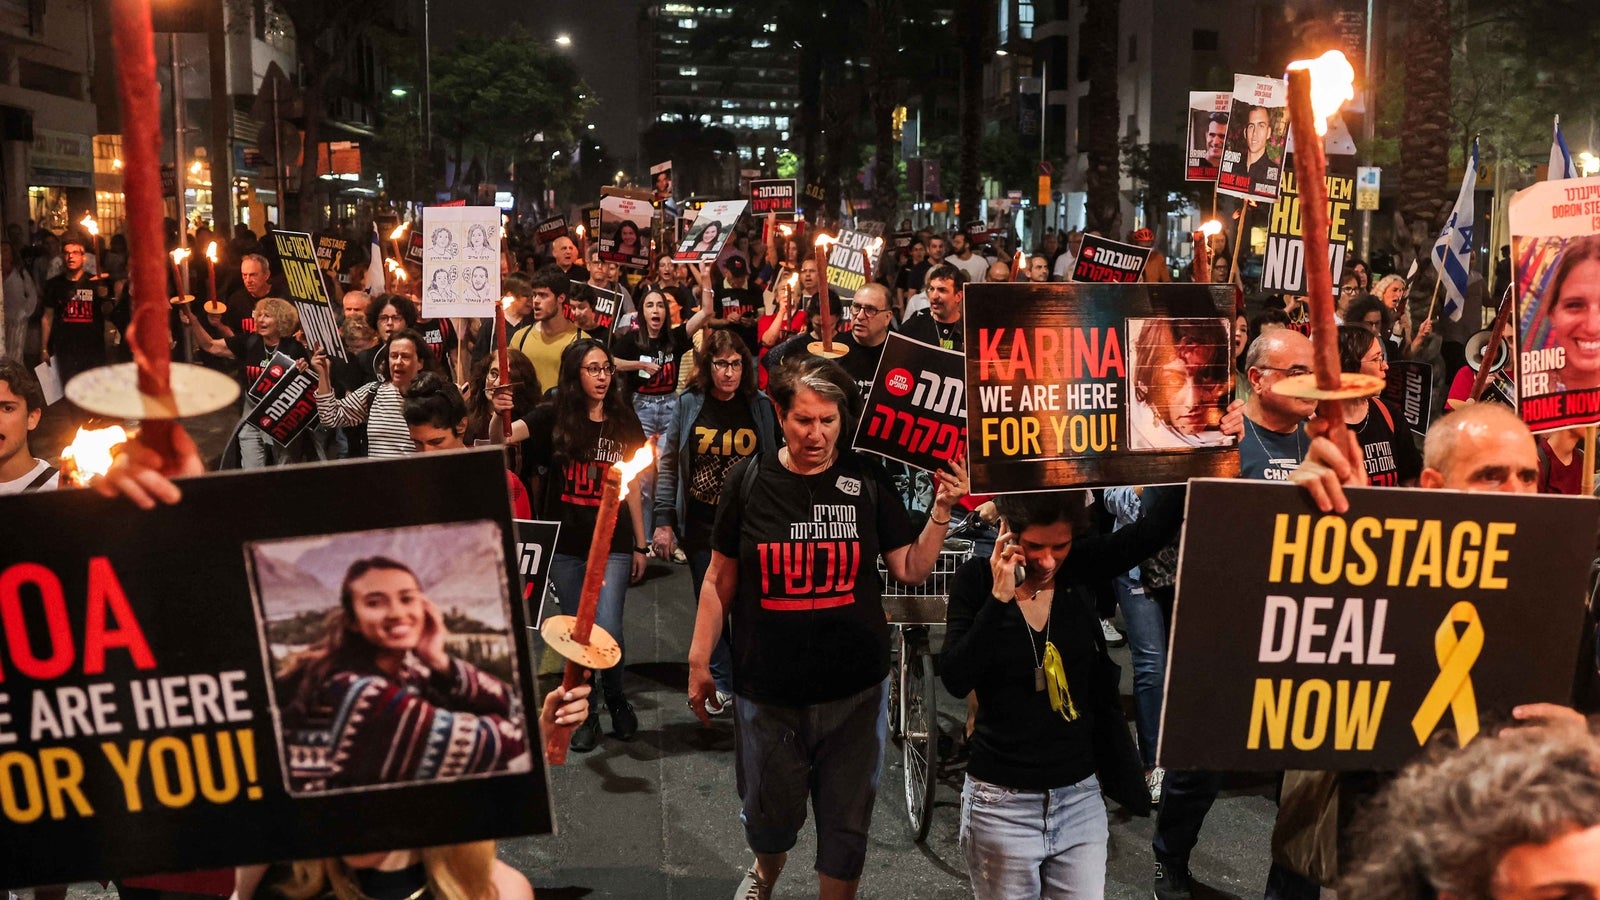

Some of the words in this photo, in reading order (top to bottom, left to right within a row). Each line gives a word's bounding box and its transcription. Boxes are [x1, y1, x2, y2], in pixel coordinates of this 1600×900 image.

[1280, 171, 1299, 194] AL
[1323, 175, 1353, 200] HEM
[1564, 184, 1600, 202] יינברכר
[1270, 196, 1350, 241] HOE
[1552, 203, 1582, 219] DORON
[1584, 200, 1600, 215] STE
[319, 236, 348, 251] HOSTAGE
[829, 244, 851, 268] NO
[1093, 247, 1143, 271] השבתה
[1264, 236, 1345, 296] NO!
[281, 258, 328, 303] HOME
[294, 300, 344, 360] NOW!
[978, 327, 1126, 381] KARINA
[1521, 346, 1566, 375] BRING
[264, 374, 312, 421] השבתה
[911, 369, 967, 419] תה
[979, 385, 1013, 413] WE
[1018, 384, 1060, 412] ARE
[1066, 382, 1118, 410] HERE
[1521, 372, 1550, 399] HER
[1522, 395, 1562, 422] HOME
[695, 426, 757, 456] 7.10
[981, 416, 1041, 457] FOR
[1048, 414, 1118, 453] YOU!
[1263, 468, 1295, 481] CHA
[1363, 458, 1379, 475] הבי
[841, 479, 860, 494] 195
[813, 504, 857, 523] מחזירים
[790, 522, 827, 540] הביתה
[830, 521, 860, 539] אותם
[1267, 512, 1517, 590] HOSTAGE
[757, 541, 861, 596] עכשיו
[0, 556, 158, 684] OA
[1258, 595, 1397, 666] DEAL
[30, 683, 123, 741] ARE
[130, 670, 253, 731] HERE
[1246, 677, 1392, 751] NOW
[0, 747, 95, 824] OR
[101, 728, 263, 813] YOU!
